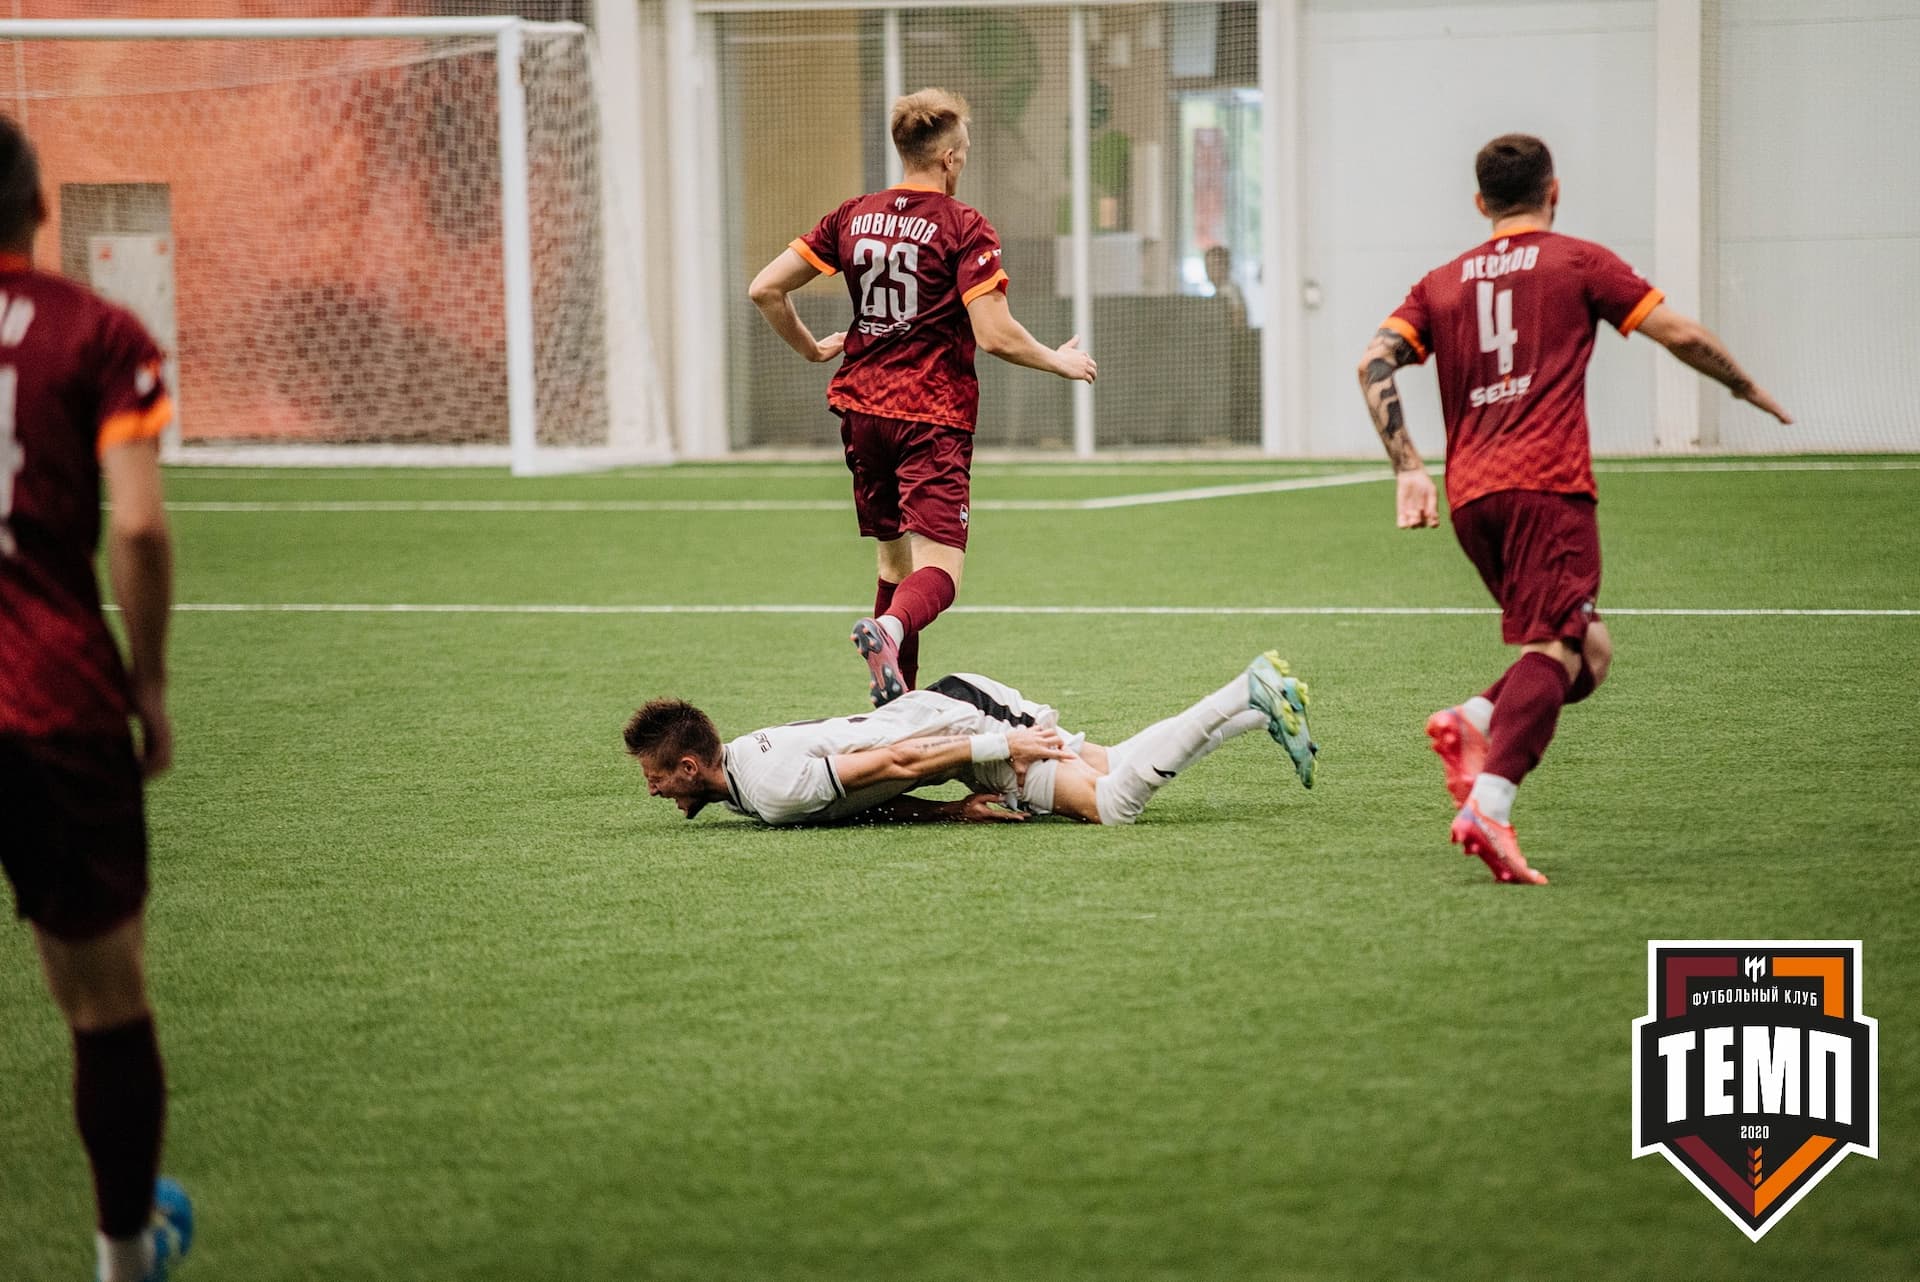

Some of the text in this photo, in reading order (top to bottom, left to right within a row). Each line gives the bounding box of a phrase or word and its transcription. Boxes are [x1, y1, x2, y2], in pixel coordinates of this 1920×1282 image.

[850, 213, 938, 244] НОВИЧКОВ
[853, 238, 919, 321] 25
[1476, 281, 1518, 375] 4
